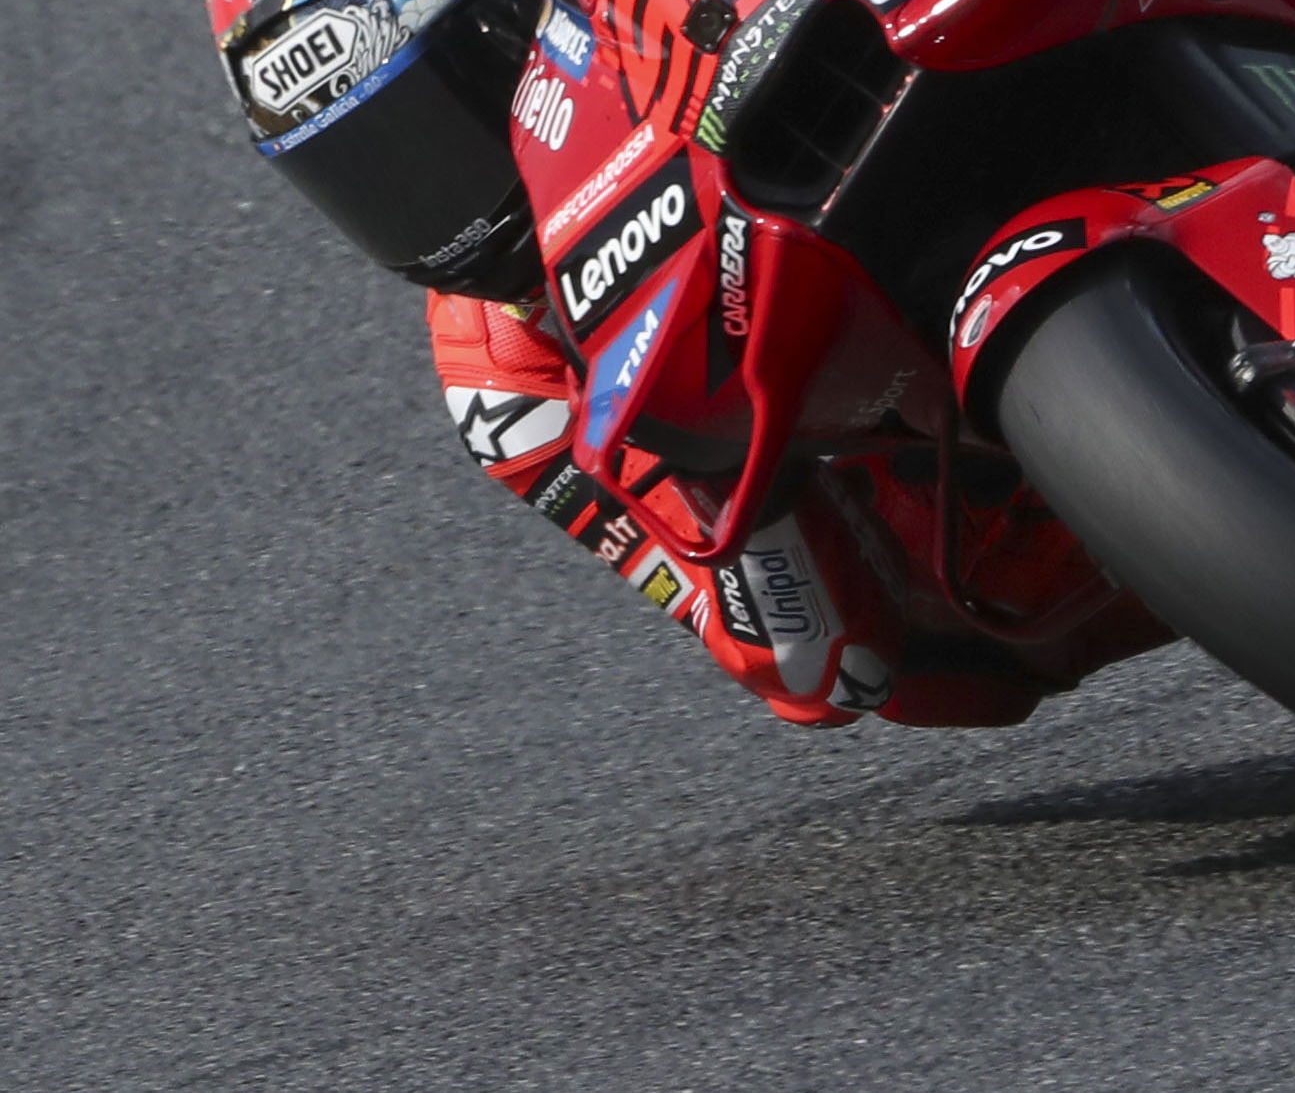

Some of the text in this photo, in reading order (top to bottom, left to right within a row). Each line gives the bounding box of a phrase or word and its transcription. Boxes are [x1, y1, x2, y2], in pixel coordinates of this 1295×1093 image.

[258, 23, 346, 103] SHOEI
[561, 183, 686, 322] Lenovo
[719, 216, 749, 337] CARRERA
[615, 309, 661, 388] TIM
[741, 547, 811, 636] Unipol
